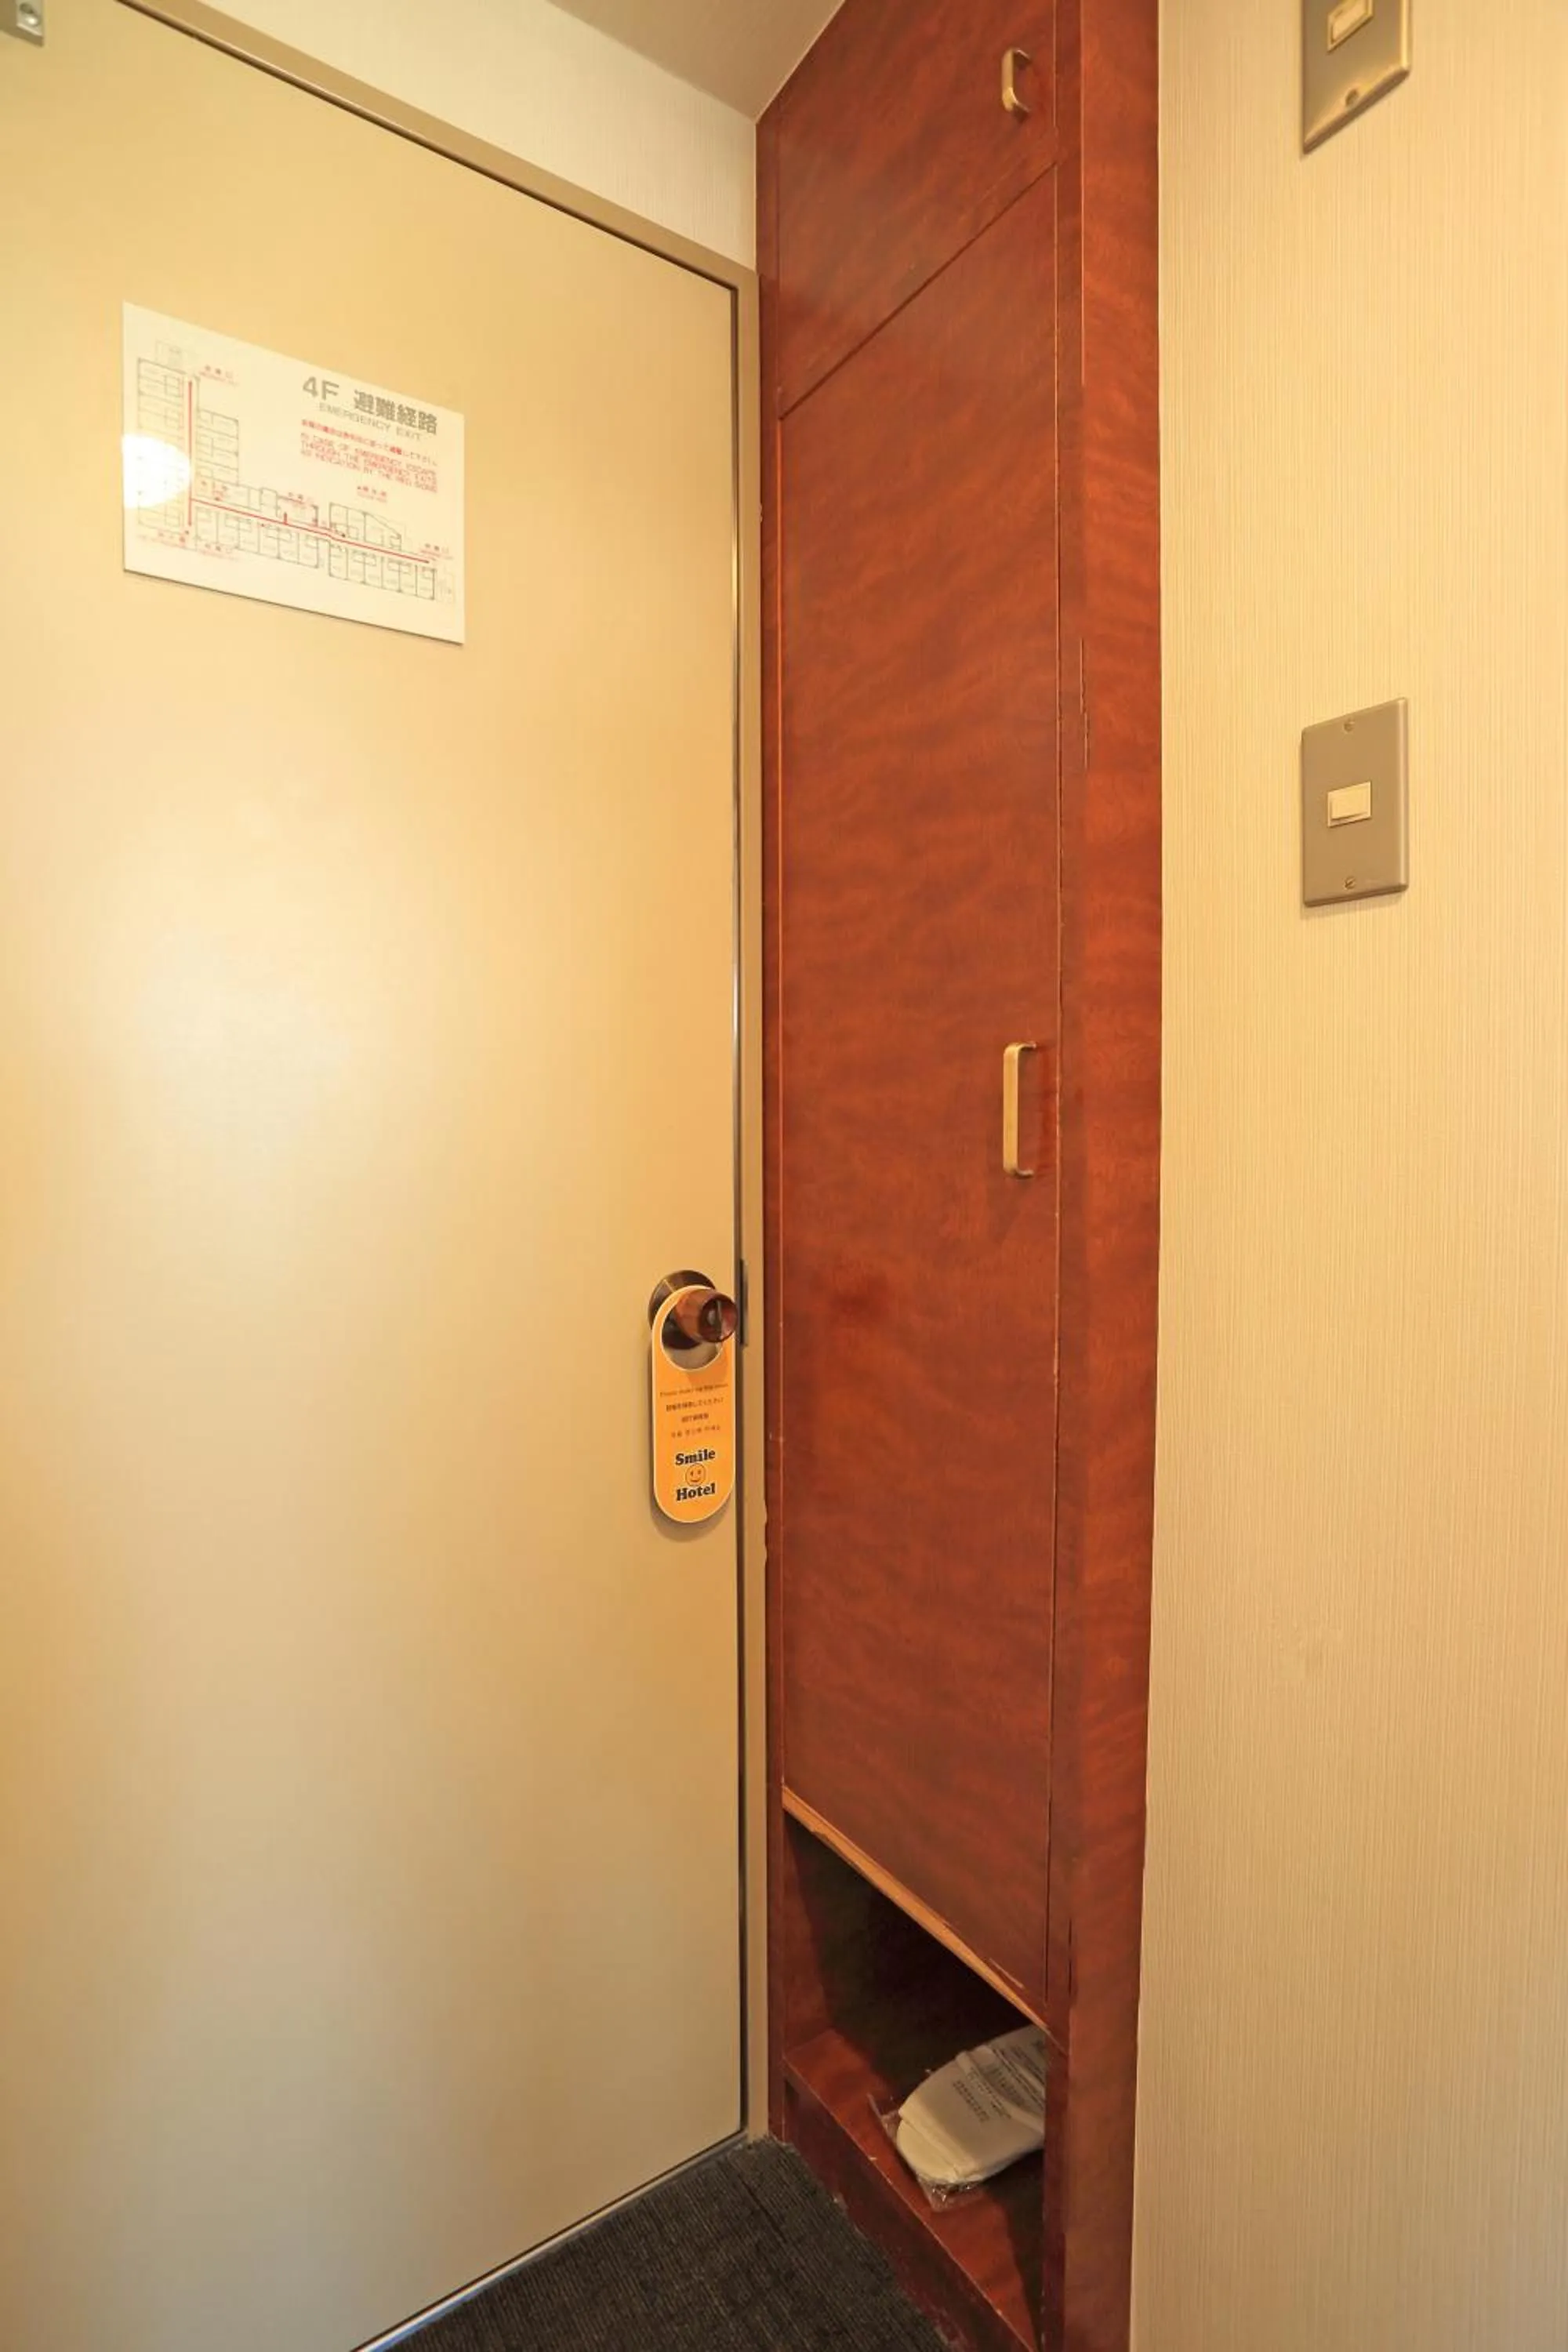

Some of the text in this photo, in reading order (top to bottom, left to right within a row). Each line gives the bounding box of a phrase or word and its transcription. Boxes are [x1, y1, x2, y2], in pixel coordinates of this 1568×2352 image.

[303, 376, 437, 435] 4F 避難経路
[319, 402, 422, 441] EMERGENCY EXIT
[675, 1448, 716, 1466] Smile
[677, 1483, 716, 1501] Hotel
